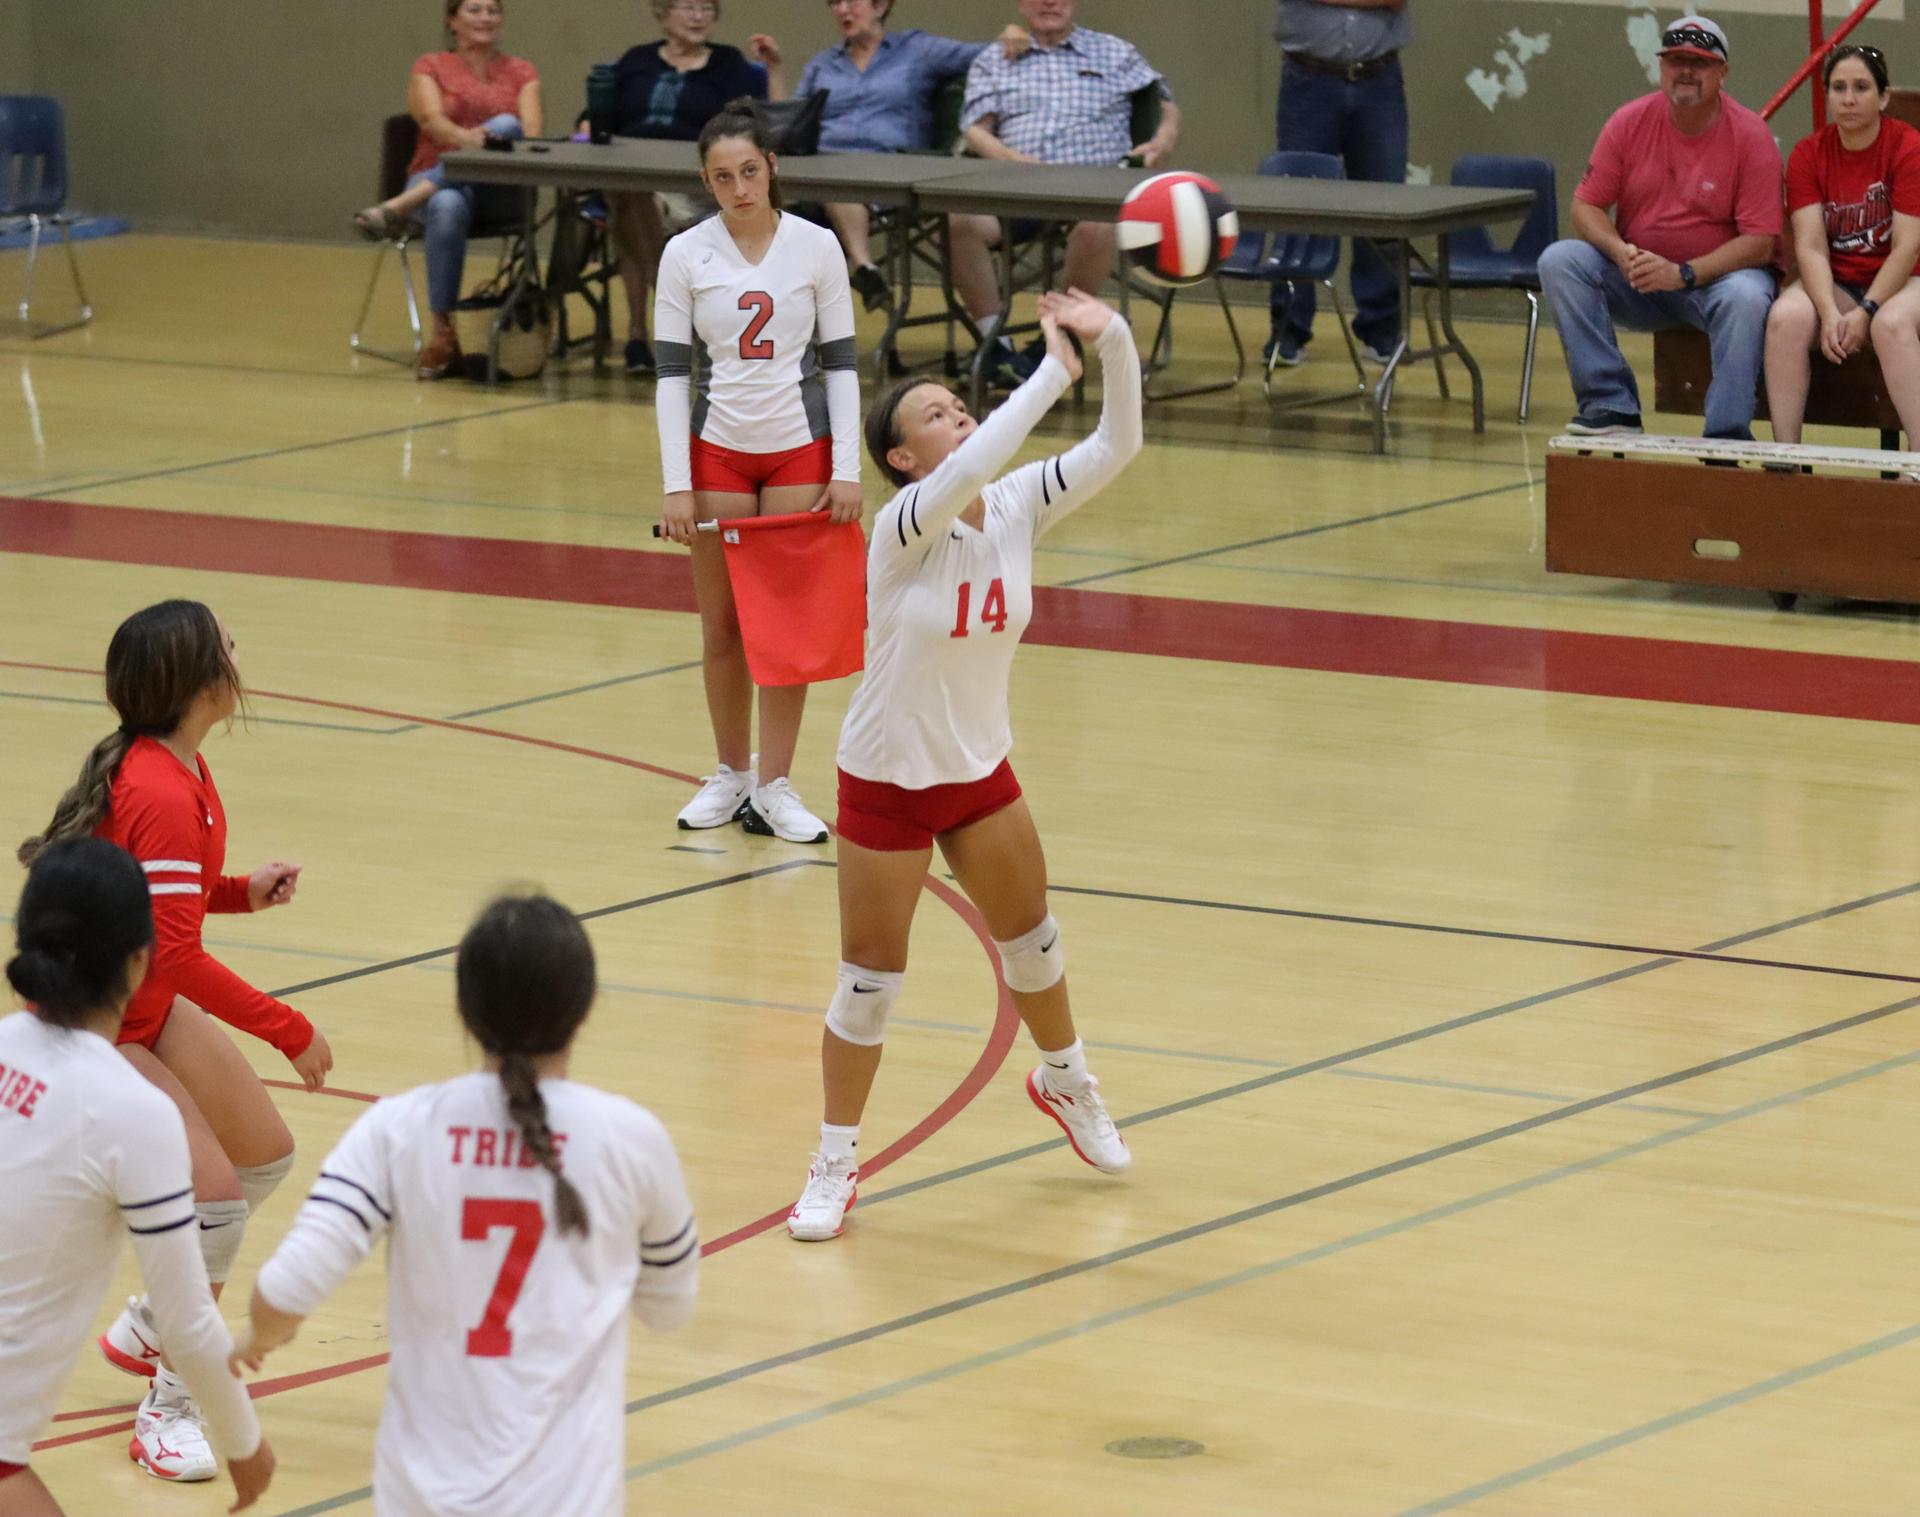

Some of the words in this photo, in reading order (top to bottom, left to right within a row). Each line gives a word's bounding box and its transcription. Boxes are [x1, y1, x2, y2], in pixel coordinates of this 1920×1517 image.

[738, 291, 774, 359] 2
[950, 577, 1008, 638] 14
[0, 1064, 48, 1118] IBE
[461, 1197, 546, 1357] 7
